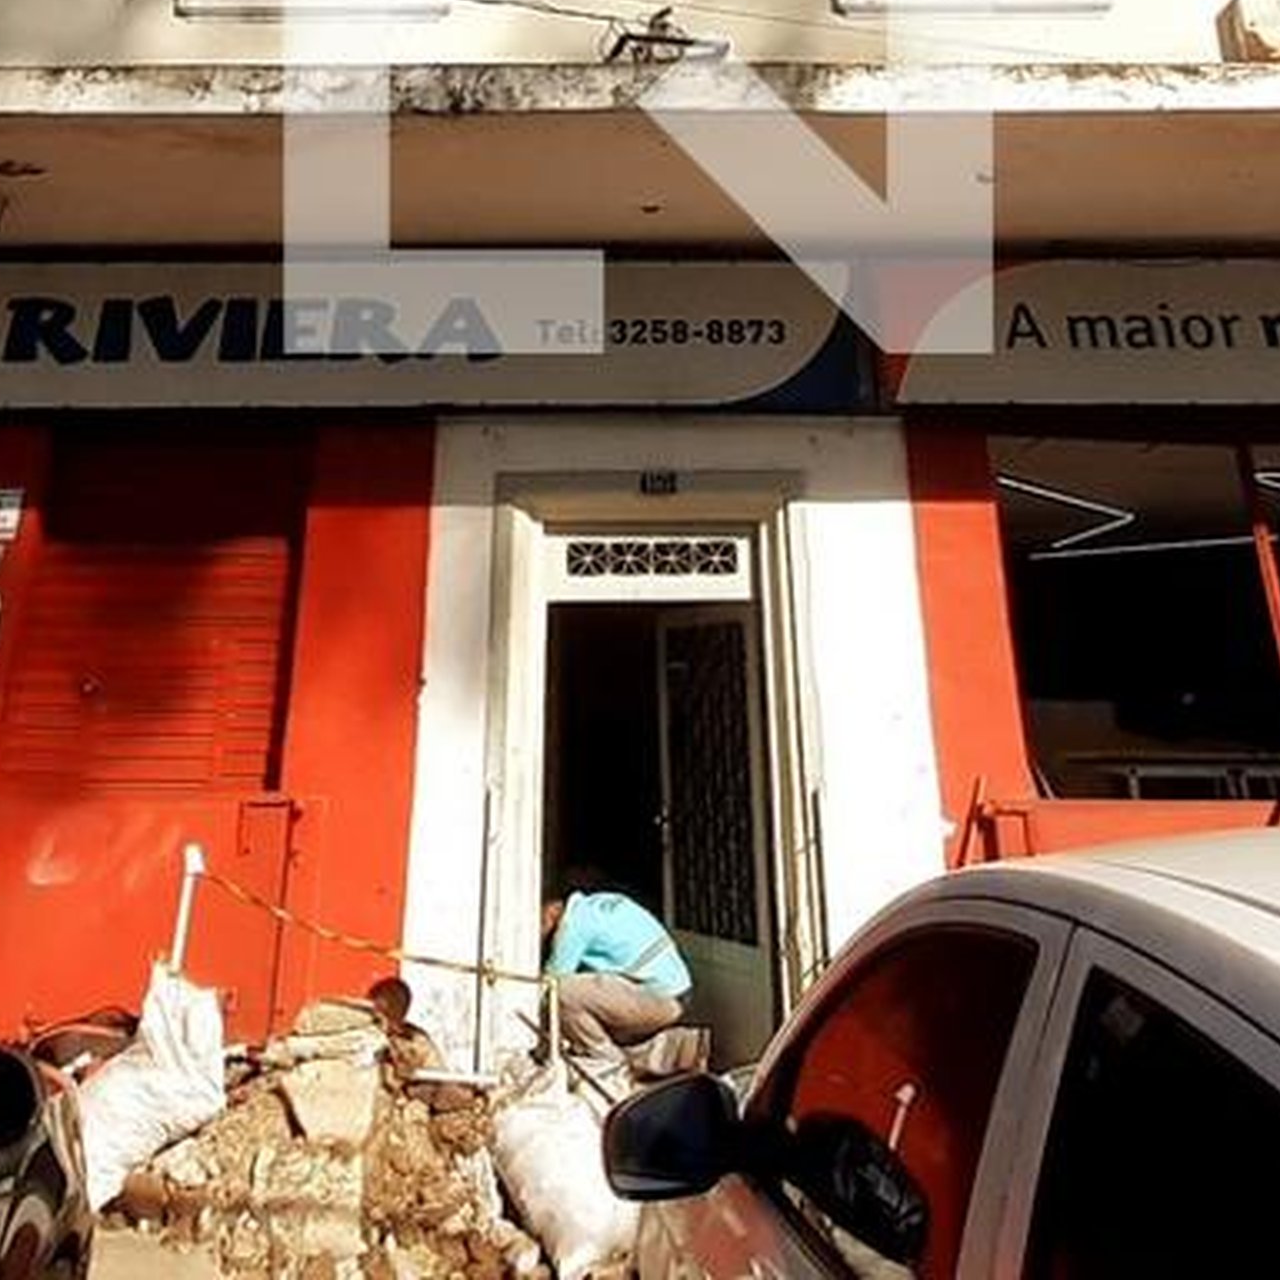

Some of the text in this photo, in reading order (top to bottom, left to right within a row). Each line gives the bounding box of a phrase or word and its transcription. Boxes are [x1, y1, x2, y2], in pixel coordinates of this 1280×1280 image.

[1, 295, 505, 364] RIVIERA
[610, 320, 787, 345] 3258-8873
[1005, 303, 1047, 350] A
[1066, 304, 1244, 349] maior
